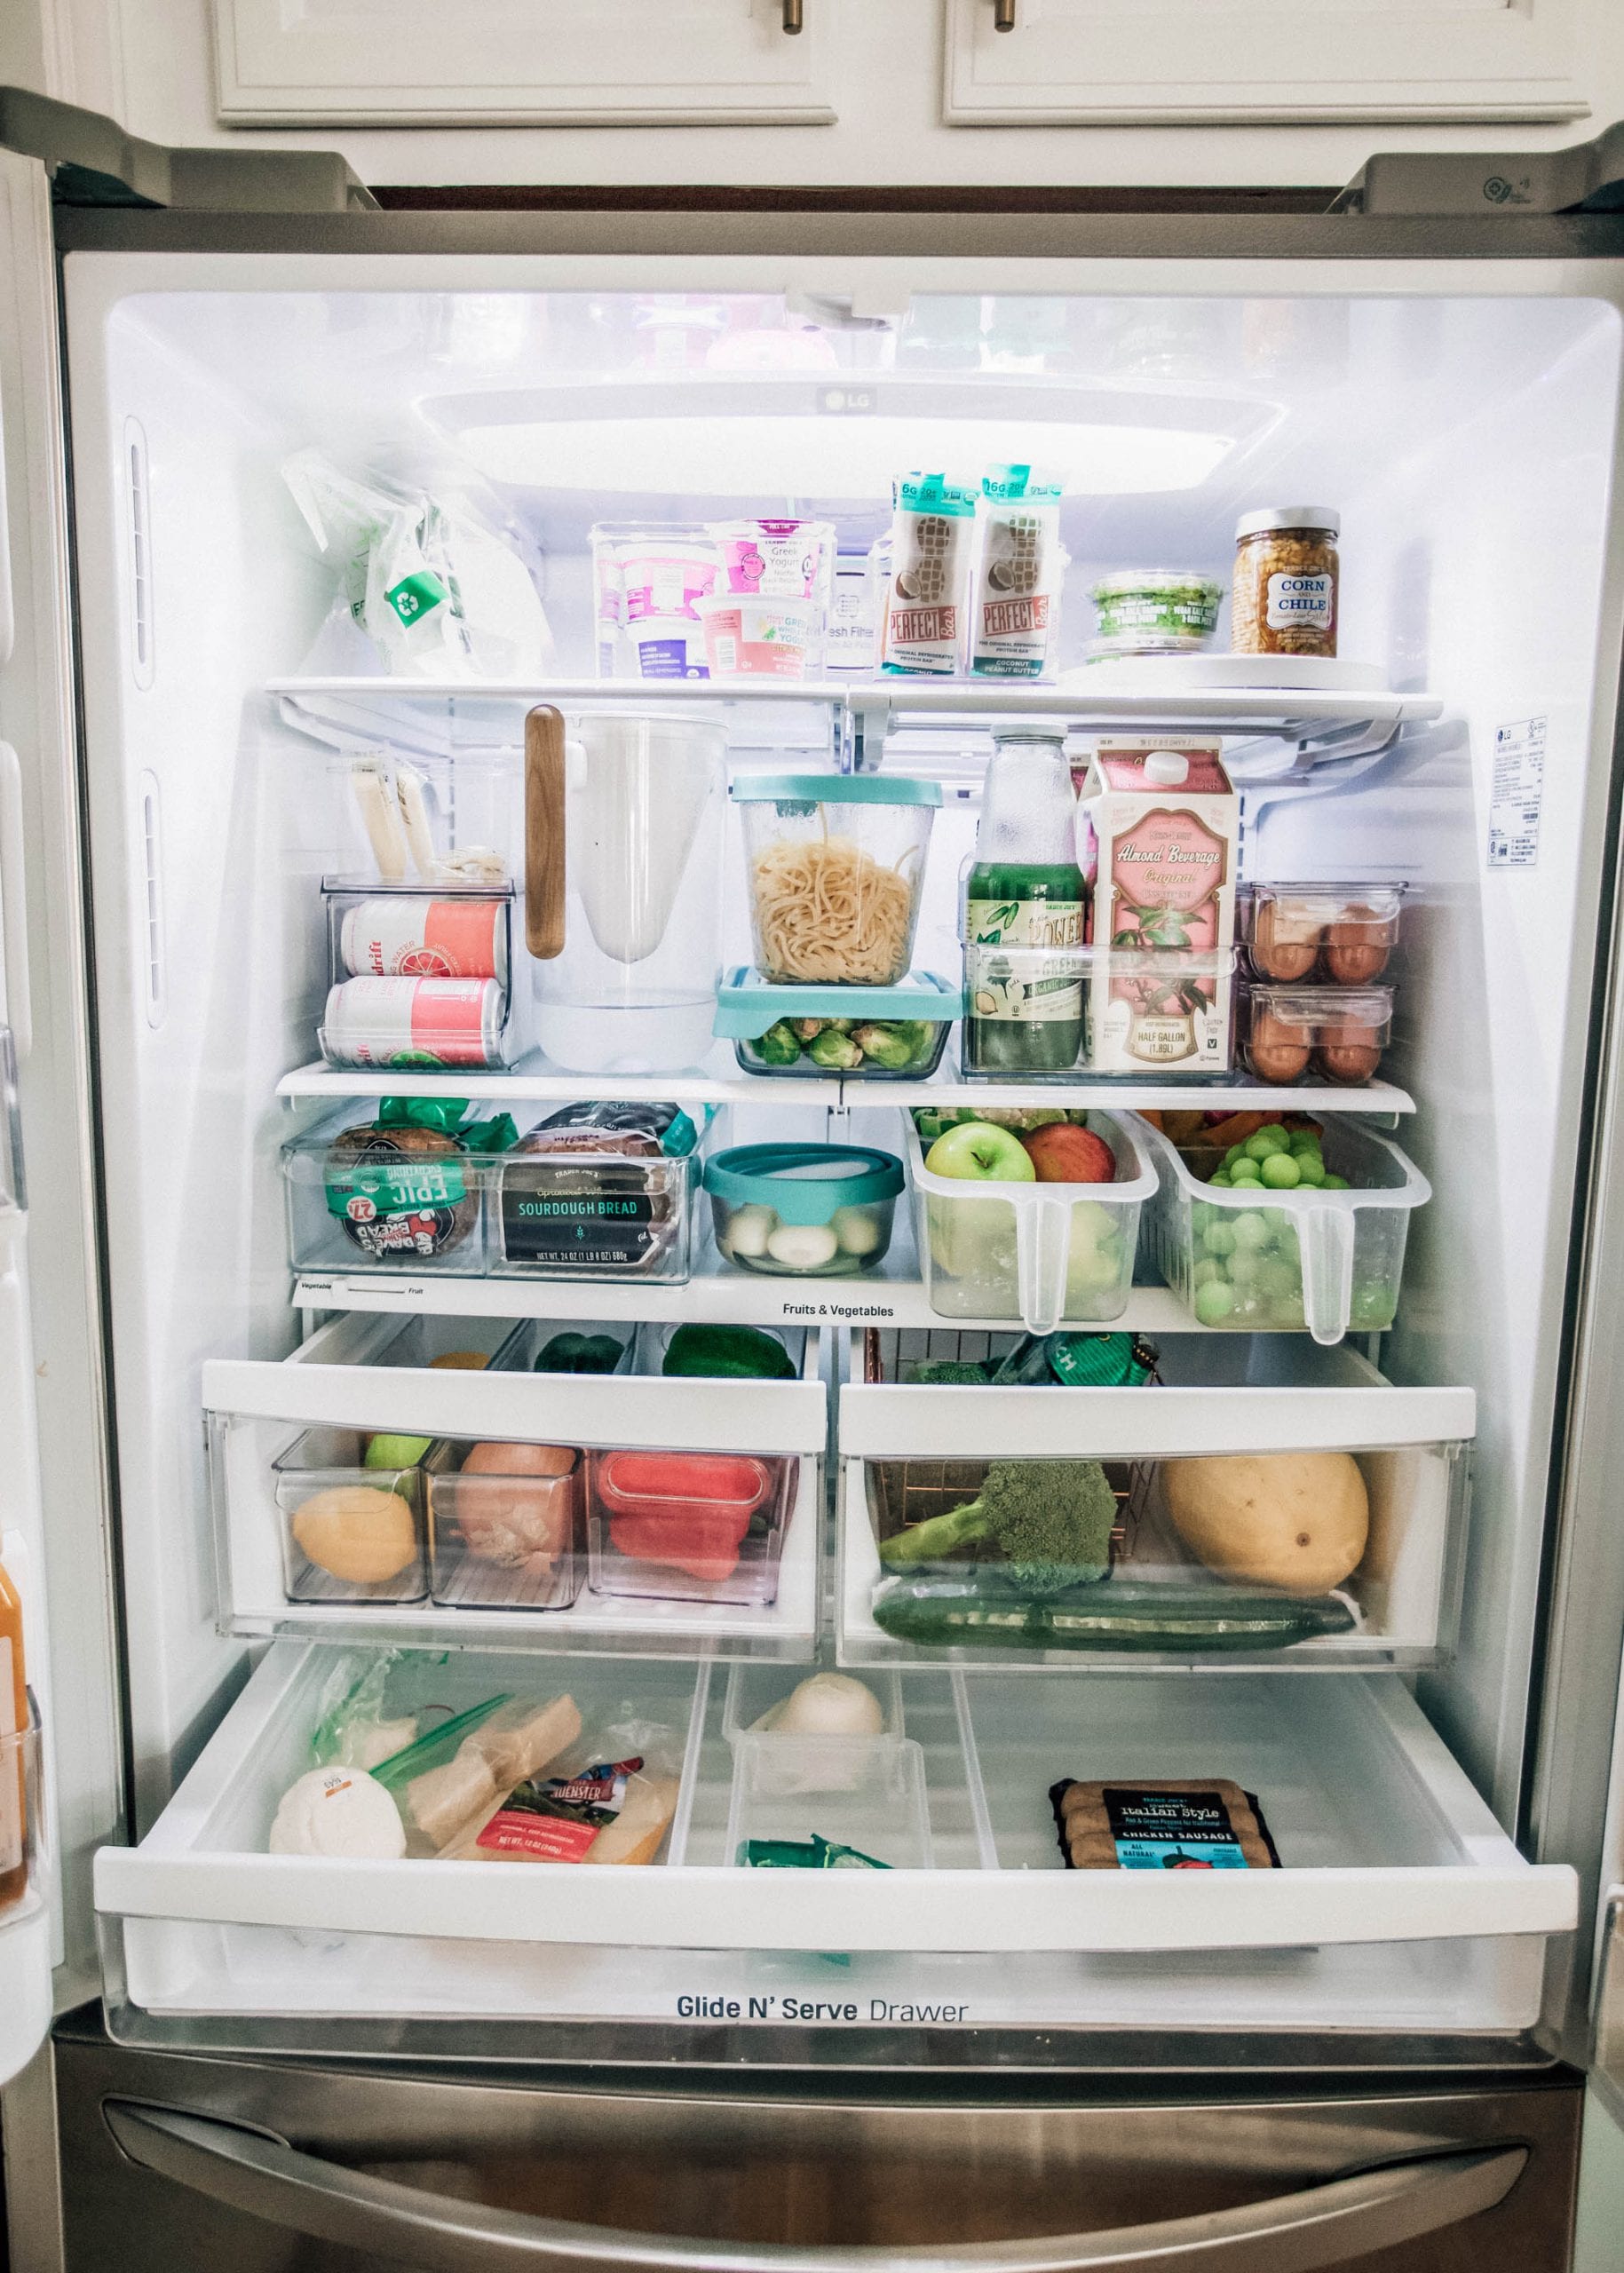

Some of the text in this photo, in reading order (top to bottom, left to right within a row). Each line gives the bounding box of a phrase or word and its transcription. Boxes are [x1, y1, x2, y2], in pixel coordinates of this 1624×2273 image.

[848, 393, 870, 408] LG
[902, 484, 916, 495] 6G
[986, 481, 1005, 493] 16G
[1281, 580, 1325, 591] CORN
[1279, 599, 1327, 611] CHILE
[985, 597, 1049, 633] PERFECT Bar
[891, 607, 955, 640] PERFECT Bar
[851, 627, 875, 638] Filte
[1504, 730, 1511, 740] LG
[1117, 843, 1221, 870] Almond Beverage
[1143, 867, 1199, 886] Original
[392, 940, 416, 962] WATER
[369, 940, 384, 976] drift
[1138, 1032, 1185, 1042] HALF GALLON
[1149, 1043, 1174, 1055] (1.89L)
[555, 1169, 580, 1179] TRADER
[392, 1174, 448, 1205] EPIC
[519, 1201, 638, 1216] SOURDOUGH BREAD
[357, 1222, 410, 1238] BREAD
[365, 1236, 416, 1250] DAVE'S
[579, 1252, 585, 1262] (1
[601, 1252, 612, 1262] OZ)
[783, 1303, 894, 1318] Fruits & Vegetables
[1121, 1807, 1220, 1820] Italian Style
[499, 1836, 512, 1845] NET
[1178, 1832, 1233, 1841] SAUSAGE
[677, 1996, 969, 2023] Glide N' Serve Drawer
